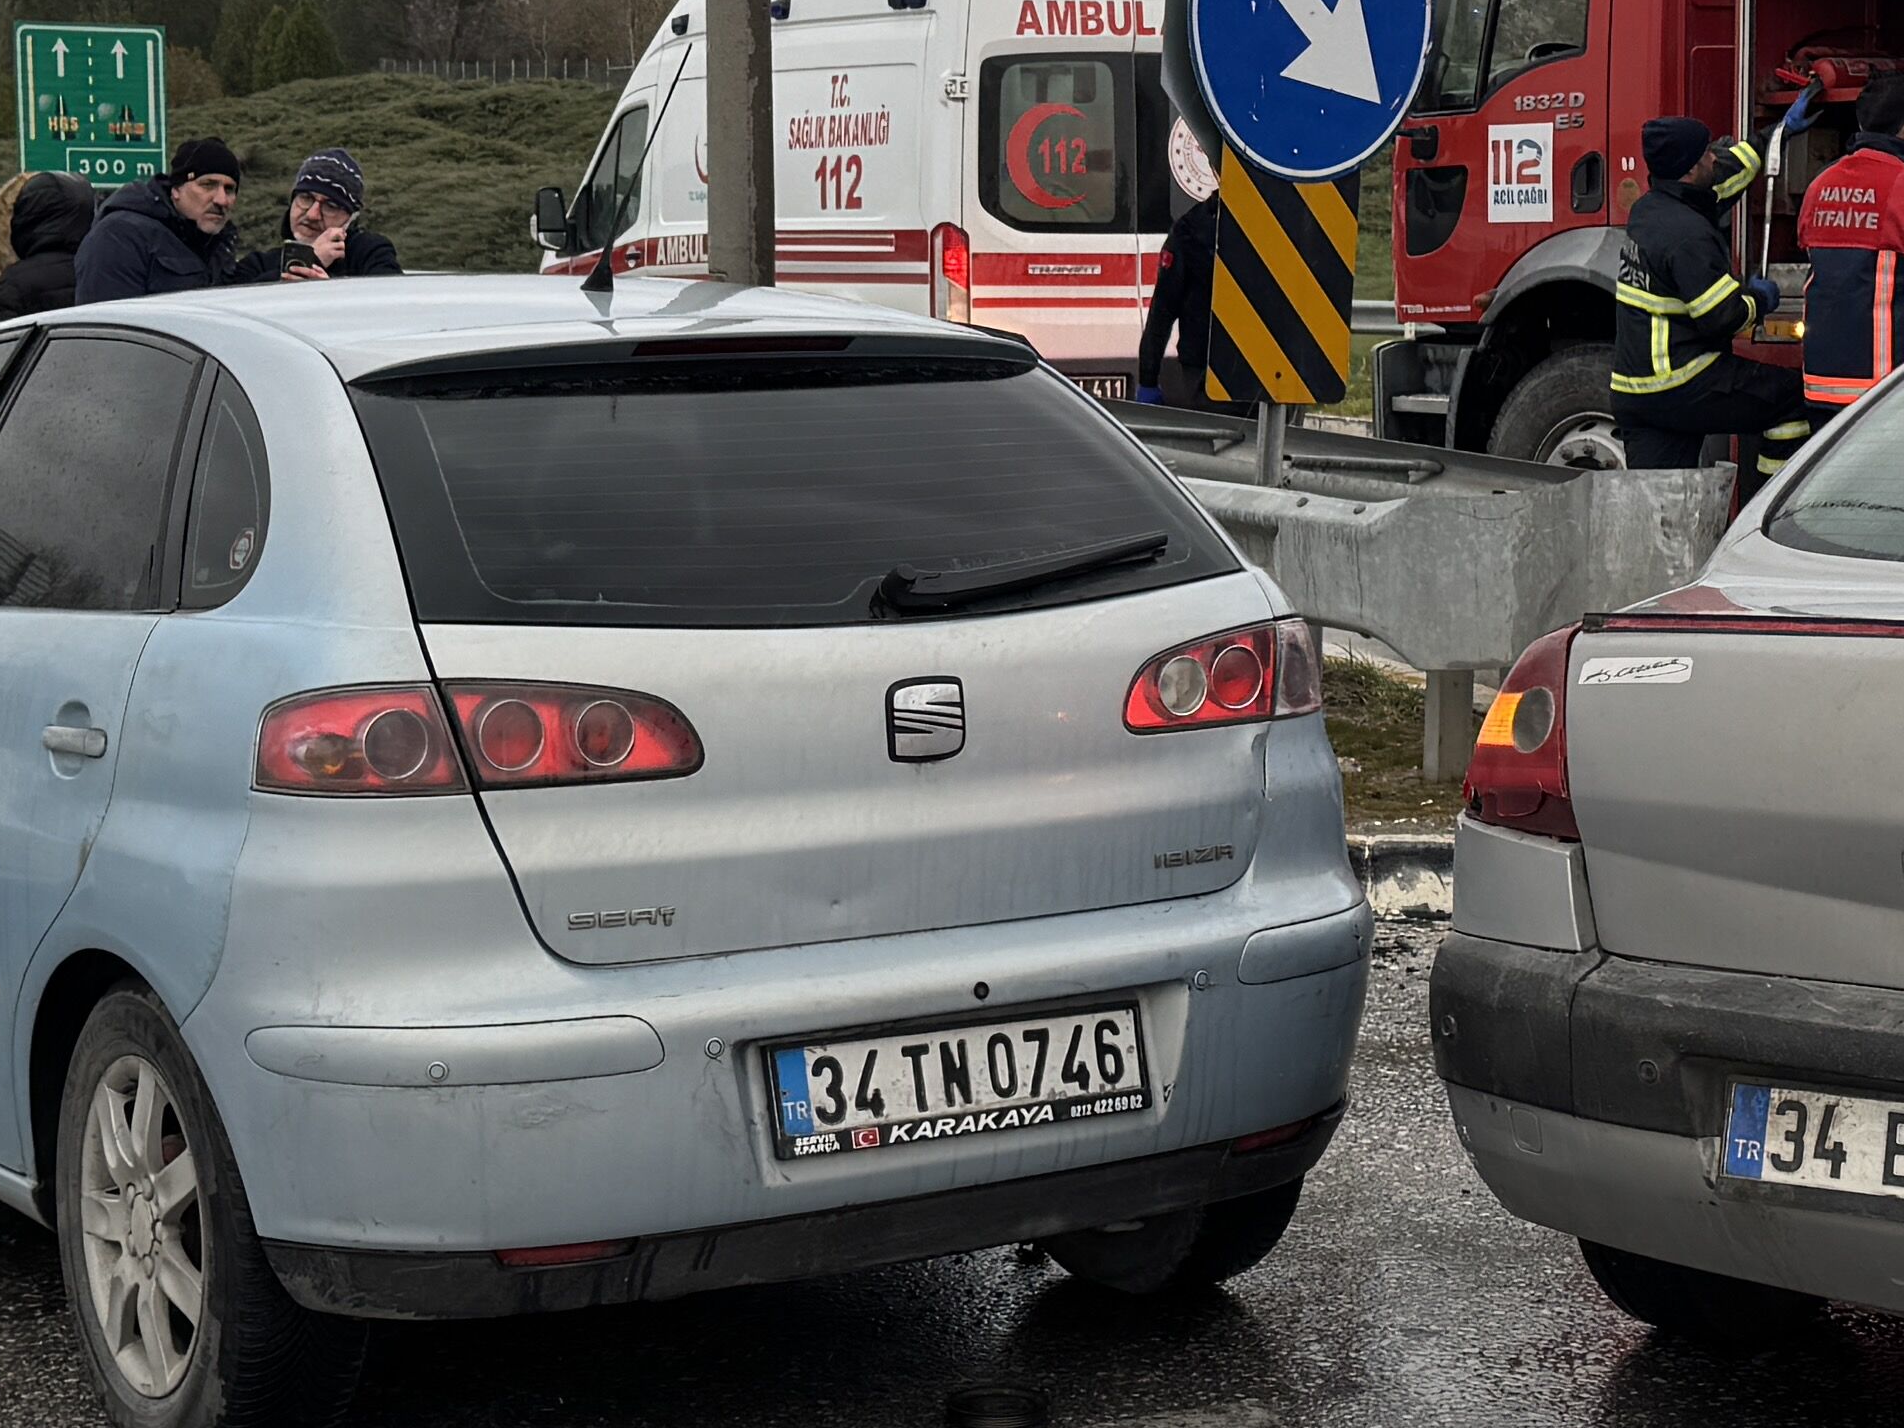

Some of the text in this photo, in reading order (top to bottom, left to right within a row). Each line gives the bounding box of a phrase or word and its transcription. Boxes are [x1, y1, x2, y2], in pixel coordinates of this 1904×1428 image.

[1015, 0, 1165, 37] AMBUL
[830, 73, 851, 109] T.C.
[1513, 92, 1566, 112] 1832
[788, 103, 890, 150] SAĞLIK BAKANLIĞI
[1554, 112, 1586, 131] E5
[79, 158, 155, 177] 300 m
[1038, 137, 1088, 175] 112
[1491, 138, 1544, 186] 112
[814, 153, 863, 211] 112
[1818, 185, 1876, 204] HAVSA
[1493, 186, 1548, 207] ACİL ÇAĞRI
[1812, 206, 1879, 230] İTFAİYE
[1153, 844, 1234, 869] IBIZA
[567, 906, 676, 931] SEAT
[810, 1018, 1126, 1127] 34 TN 0746
[782, 1100, 811, 1122] TR
[1093, 1098, 1114, 1114] 422
[888, 1103, 1055, 1144] KARAKAYA
[1734, 1138, 1761, 1162] TR
[1769, 1098, 1848, 1180] 34
